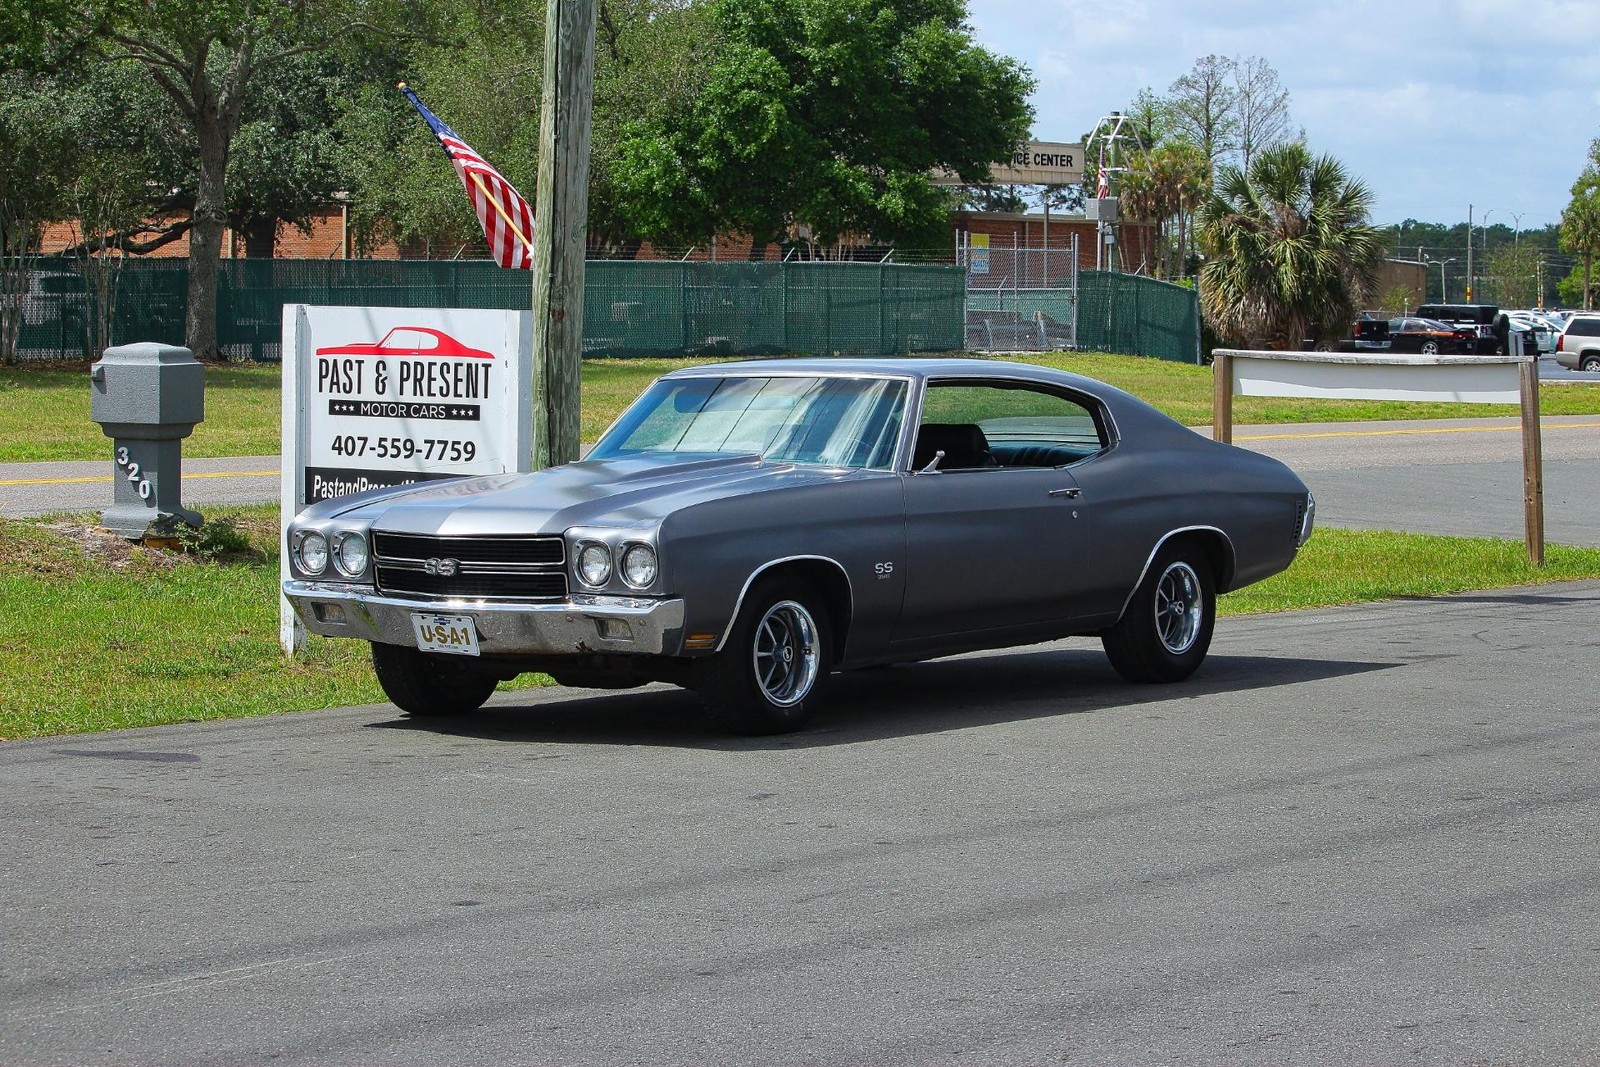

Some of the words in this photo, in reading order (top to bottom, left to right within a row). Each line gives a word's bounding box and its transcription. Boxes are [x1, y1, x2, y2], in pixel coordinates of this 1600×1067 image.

[1033, 153, 1073, 167] CENTER
[318, 358, 364, 394] PAST
[375, 360, 388, 395] &
[399, 361, 492, 399] PRESENT
[360, 403, 407, 417] MOTOR
[410, 405, 446, 418] CARS
[331, 435, 476, 462] 407-559-7759
[118, 447, 150, 498] 320
[424, 557, 459, 576] SS
[875, 561, 893, 574] SS
